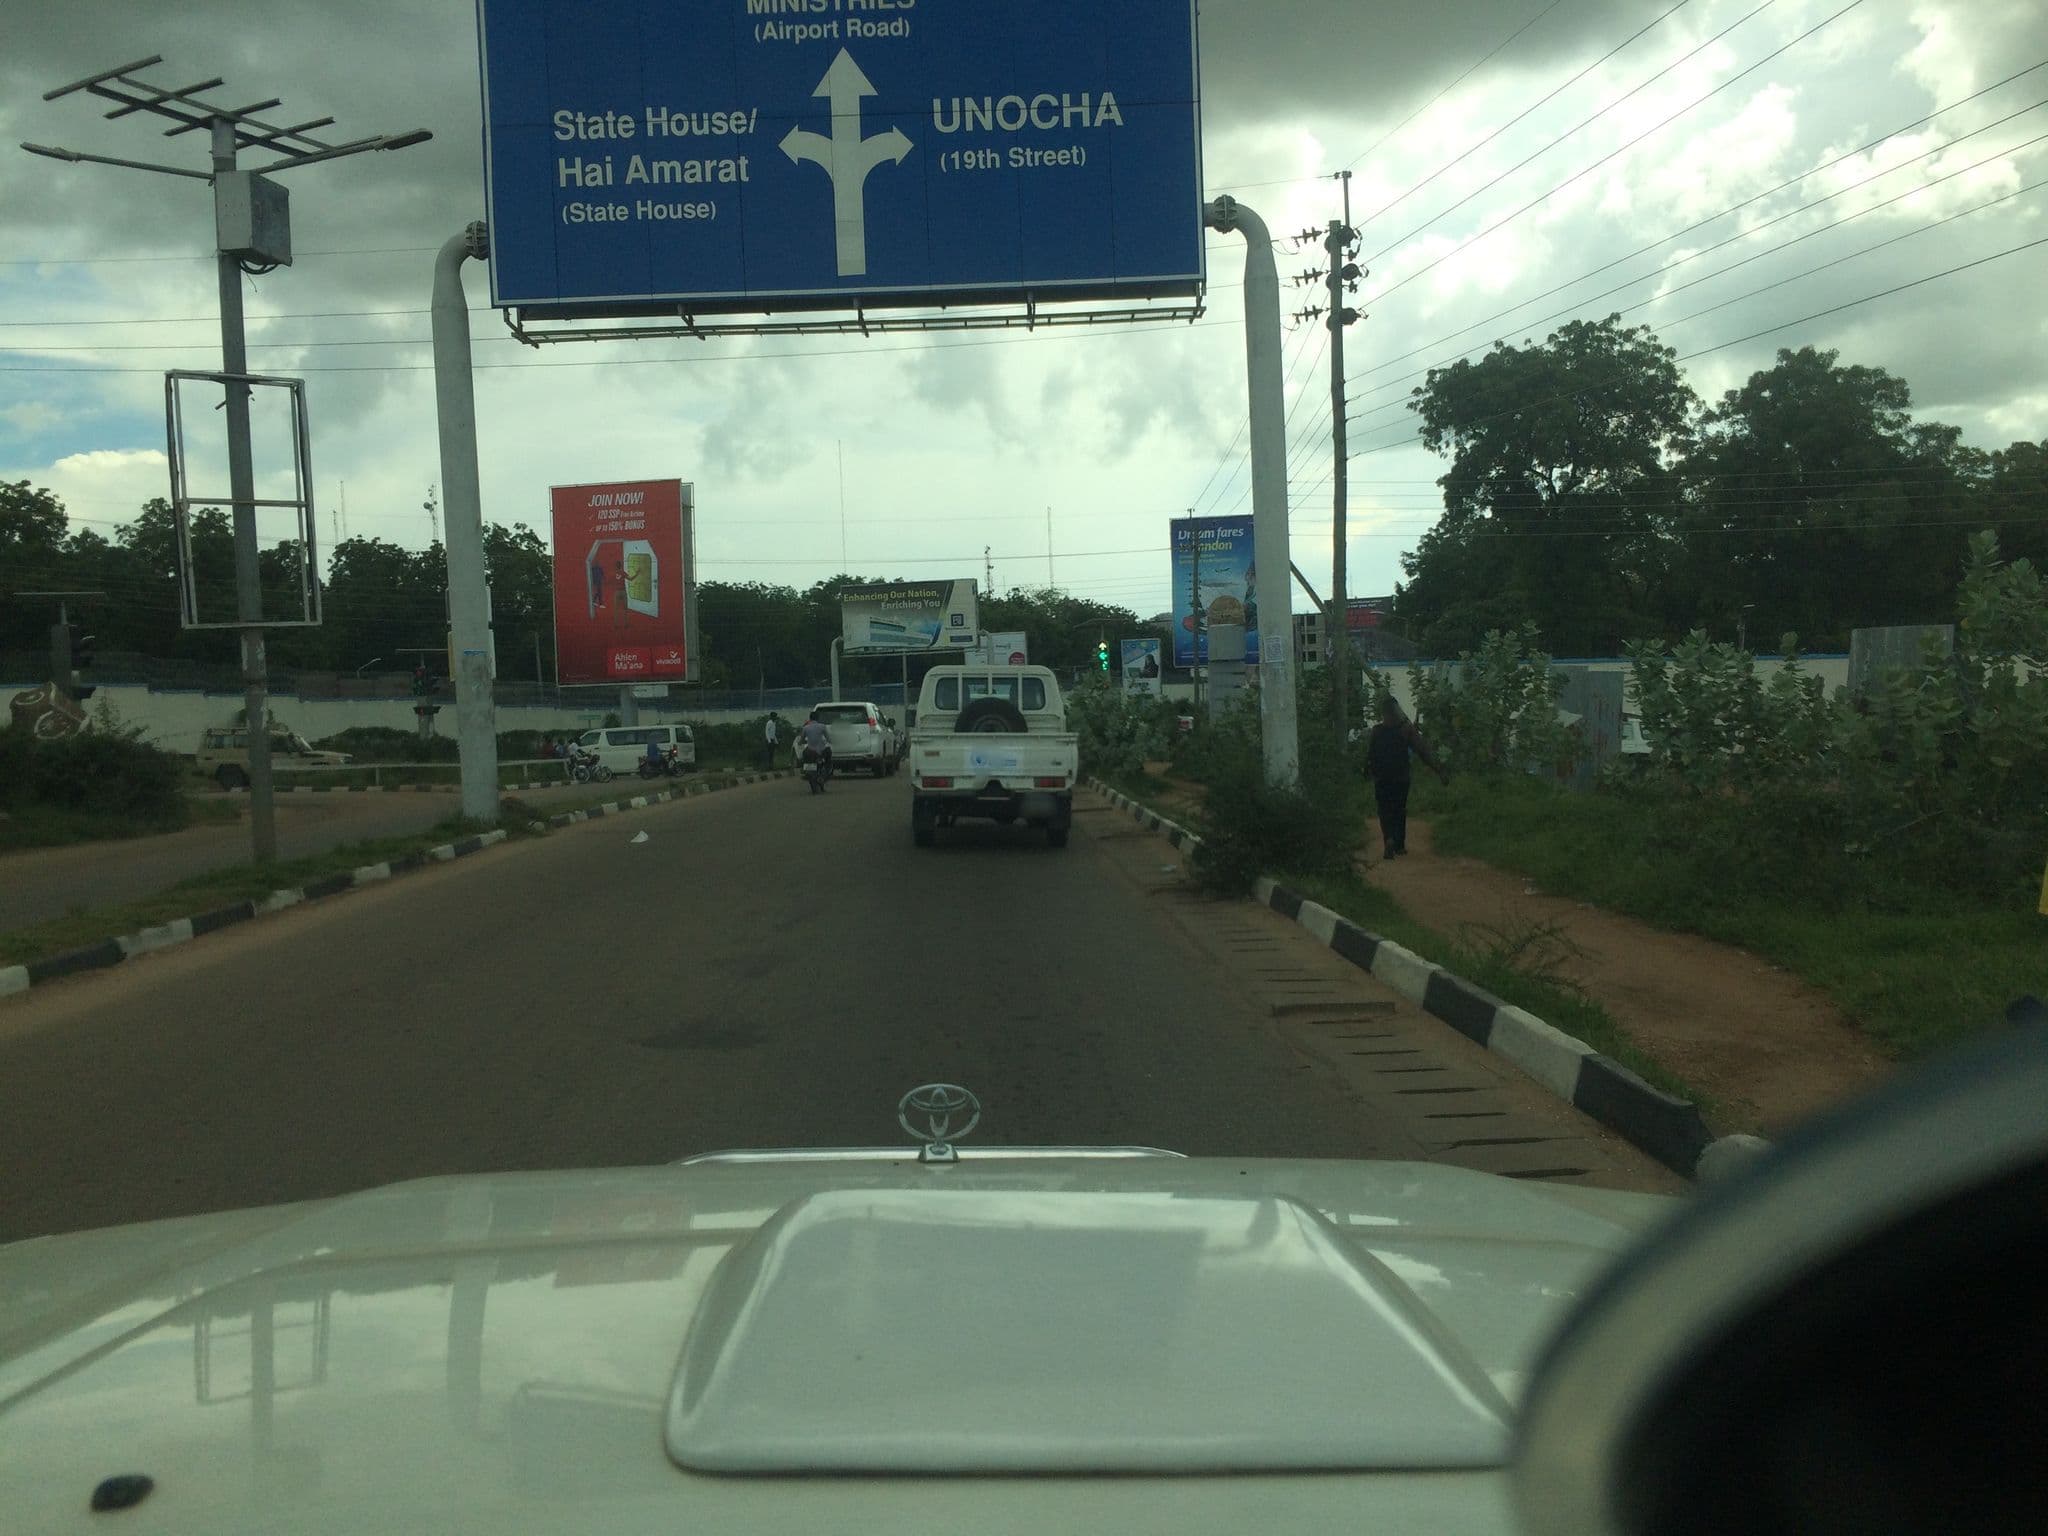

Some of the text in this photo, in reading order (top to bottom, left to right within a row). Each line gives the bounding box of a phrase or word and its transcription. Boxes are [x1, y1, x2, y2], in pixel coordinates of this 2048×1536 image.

[755, 18, 910, 44] (Airport Road)
[553, 107, 758, 141] State House/
[932, 92, 1124, 133] UNOCHA
[558, 154, 750, 187] Hai Amarat
[940, 146, 1087, 172] (19th Street)
[562, 200, 717, 224] (State House)
[588, 492, 644, 507] JOIN NOW!
[1216, 527, 1244, 540] fares
[843, 589, 939, 602] Enhancing Our Nation,
[881, 599, 941, 610] Enriching You
